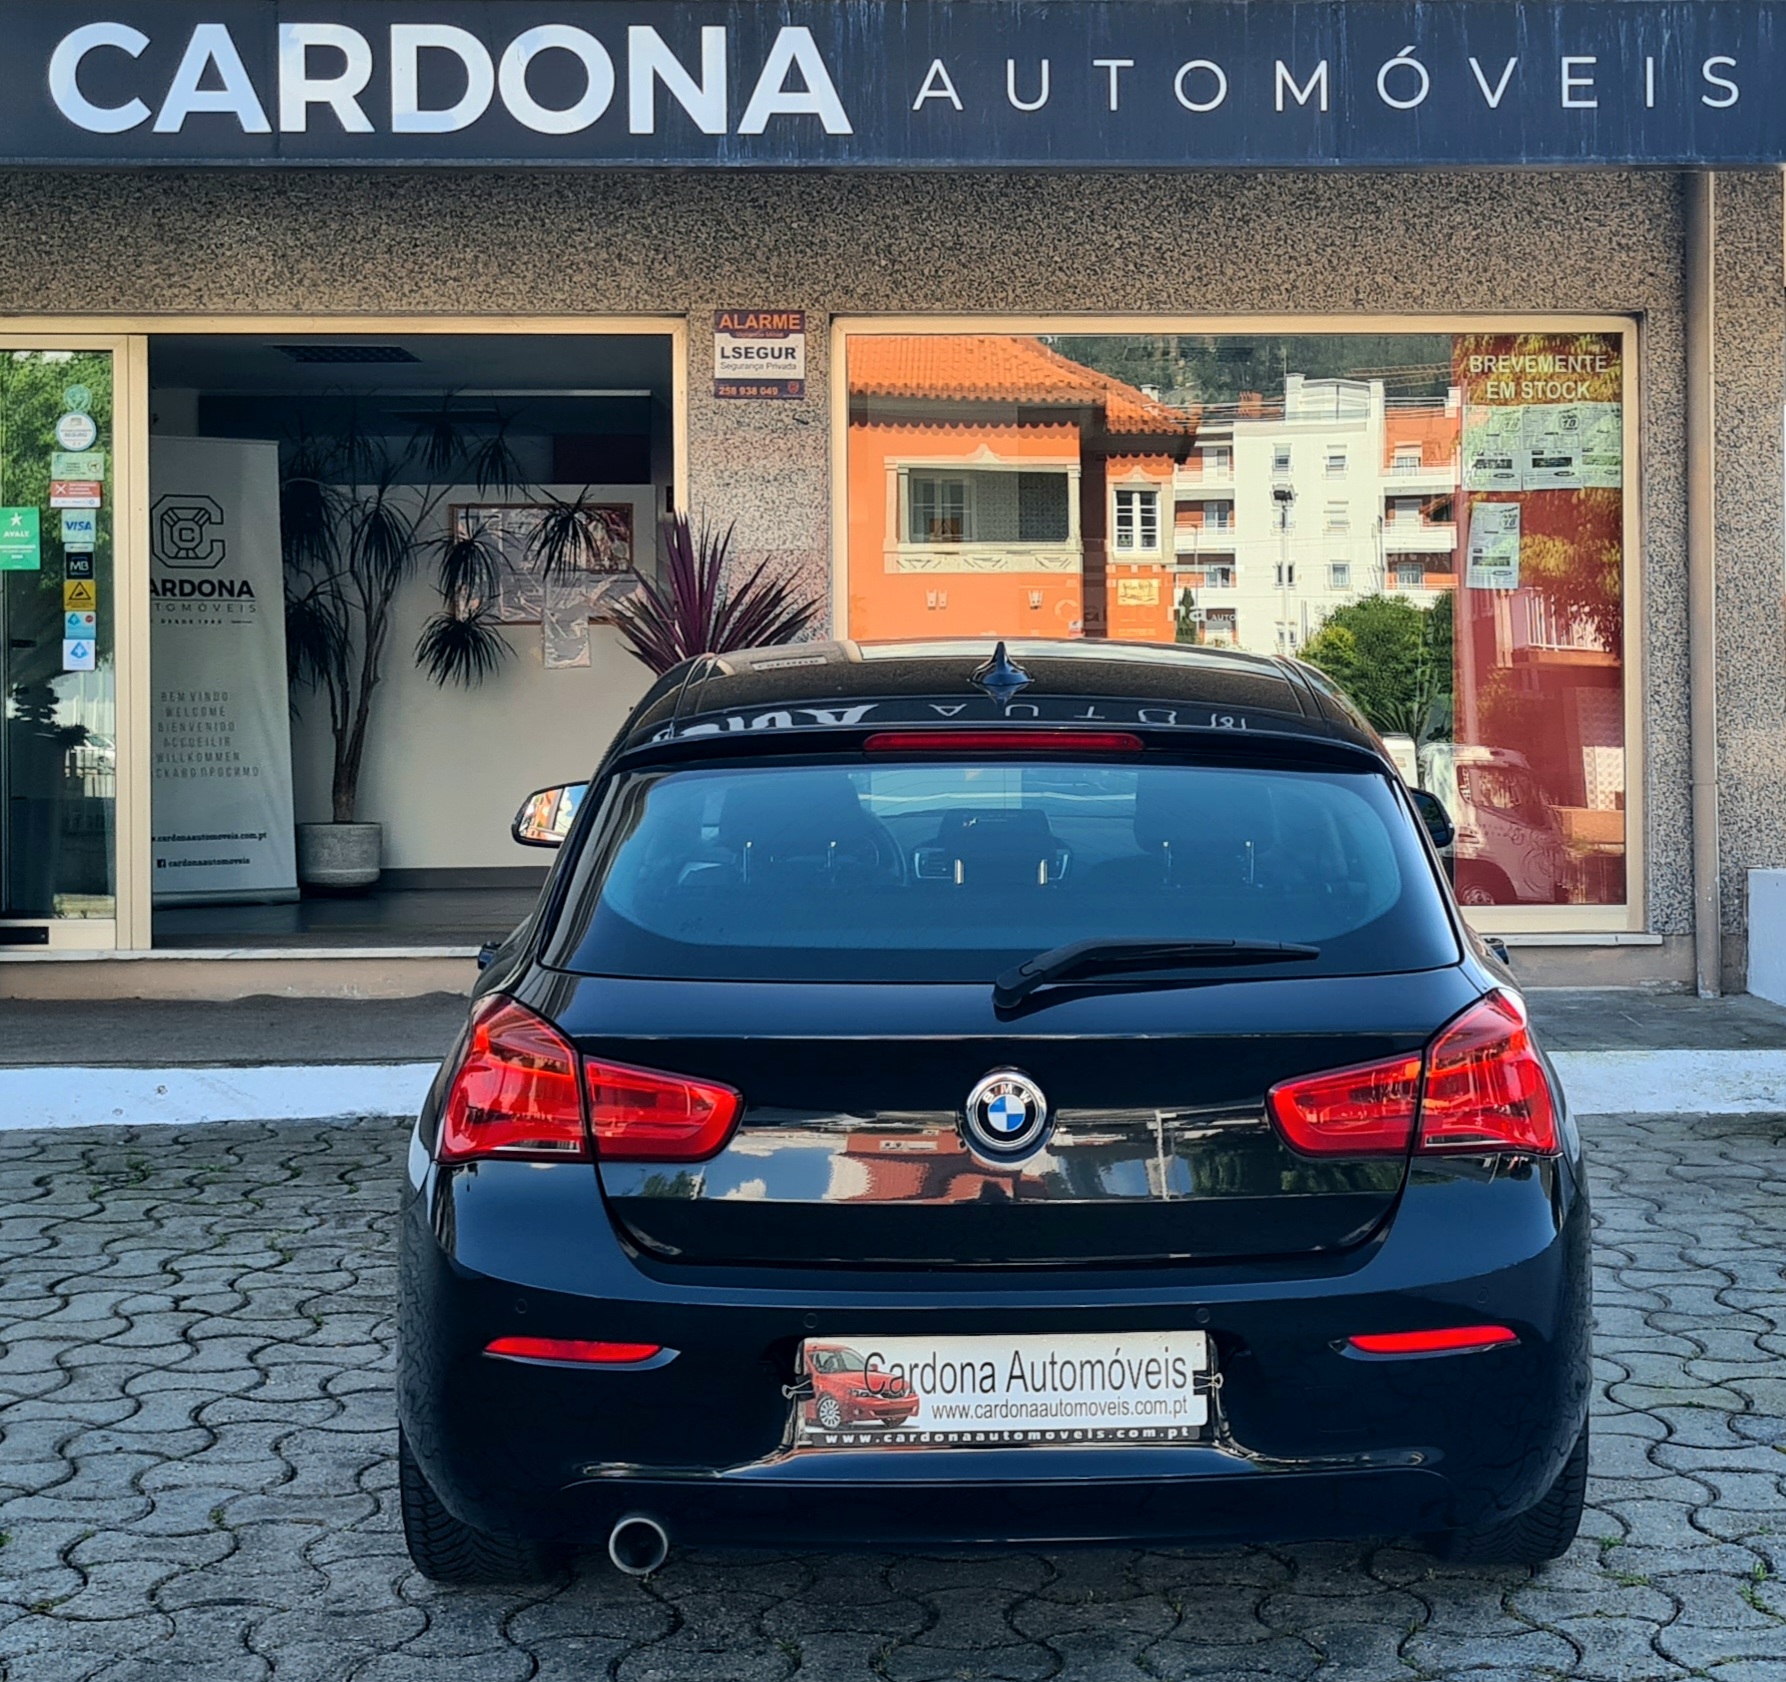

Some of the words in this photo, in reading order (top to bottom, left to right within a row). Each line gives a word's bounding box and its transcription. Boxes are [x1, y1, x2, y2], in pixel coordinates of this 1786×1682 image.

[48, 22, 853, 135] CARDONA
[912, 46, 1740, 112] AUTOMÓVEIS
[719, 313, 801, 330] ALARME
[720, 346, 796, 360] LSEGUR
[720, 362, 764, 371] Segurança
[766, 362, 797, 370] Privada
[1469, 355, 1609, 373] BREVEMENTE
[1486, 381, 1516, 399] EM
[1521, 381, 1591, 399] STOCK
[65, 521, 92, 531] VISA
[70, 560, 90, 571] MB
[150, 578, 256, 598] ARDONA
[155, 601, 257, 613] TOMÓVEIS
[161, 691, 186, 702] BEM
[190, 691, 229, 702] VINDO
[165, 705, 227, 718] WELCOME
[157, 721, 236, 733] BIENVENIDO
[155, 751, 241, 763] WILLKOMMEN
[168, 857, 251, 868] cardonaautomoveis
[982, 1083, 1033, 1105] BMW
[864, 1351, 996, 1395] Cardona
[1006, 1346, 1188, 1394] Automóveis
[931, 1394, 1188, 1420] www.cardonaautomoveis.com.pt
[825, 1425, 1191, 1444] www.cardonaautomoveis.com.pt
